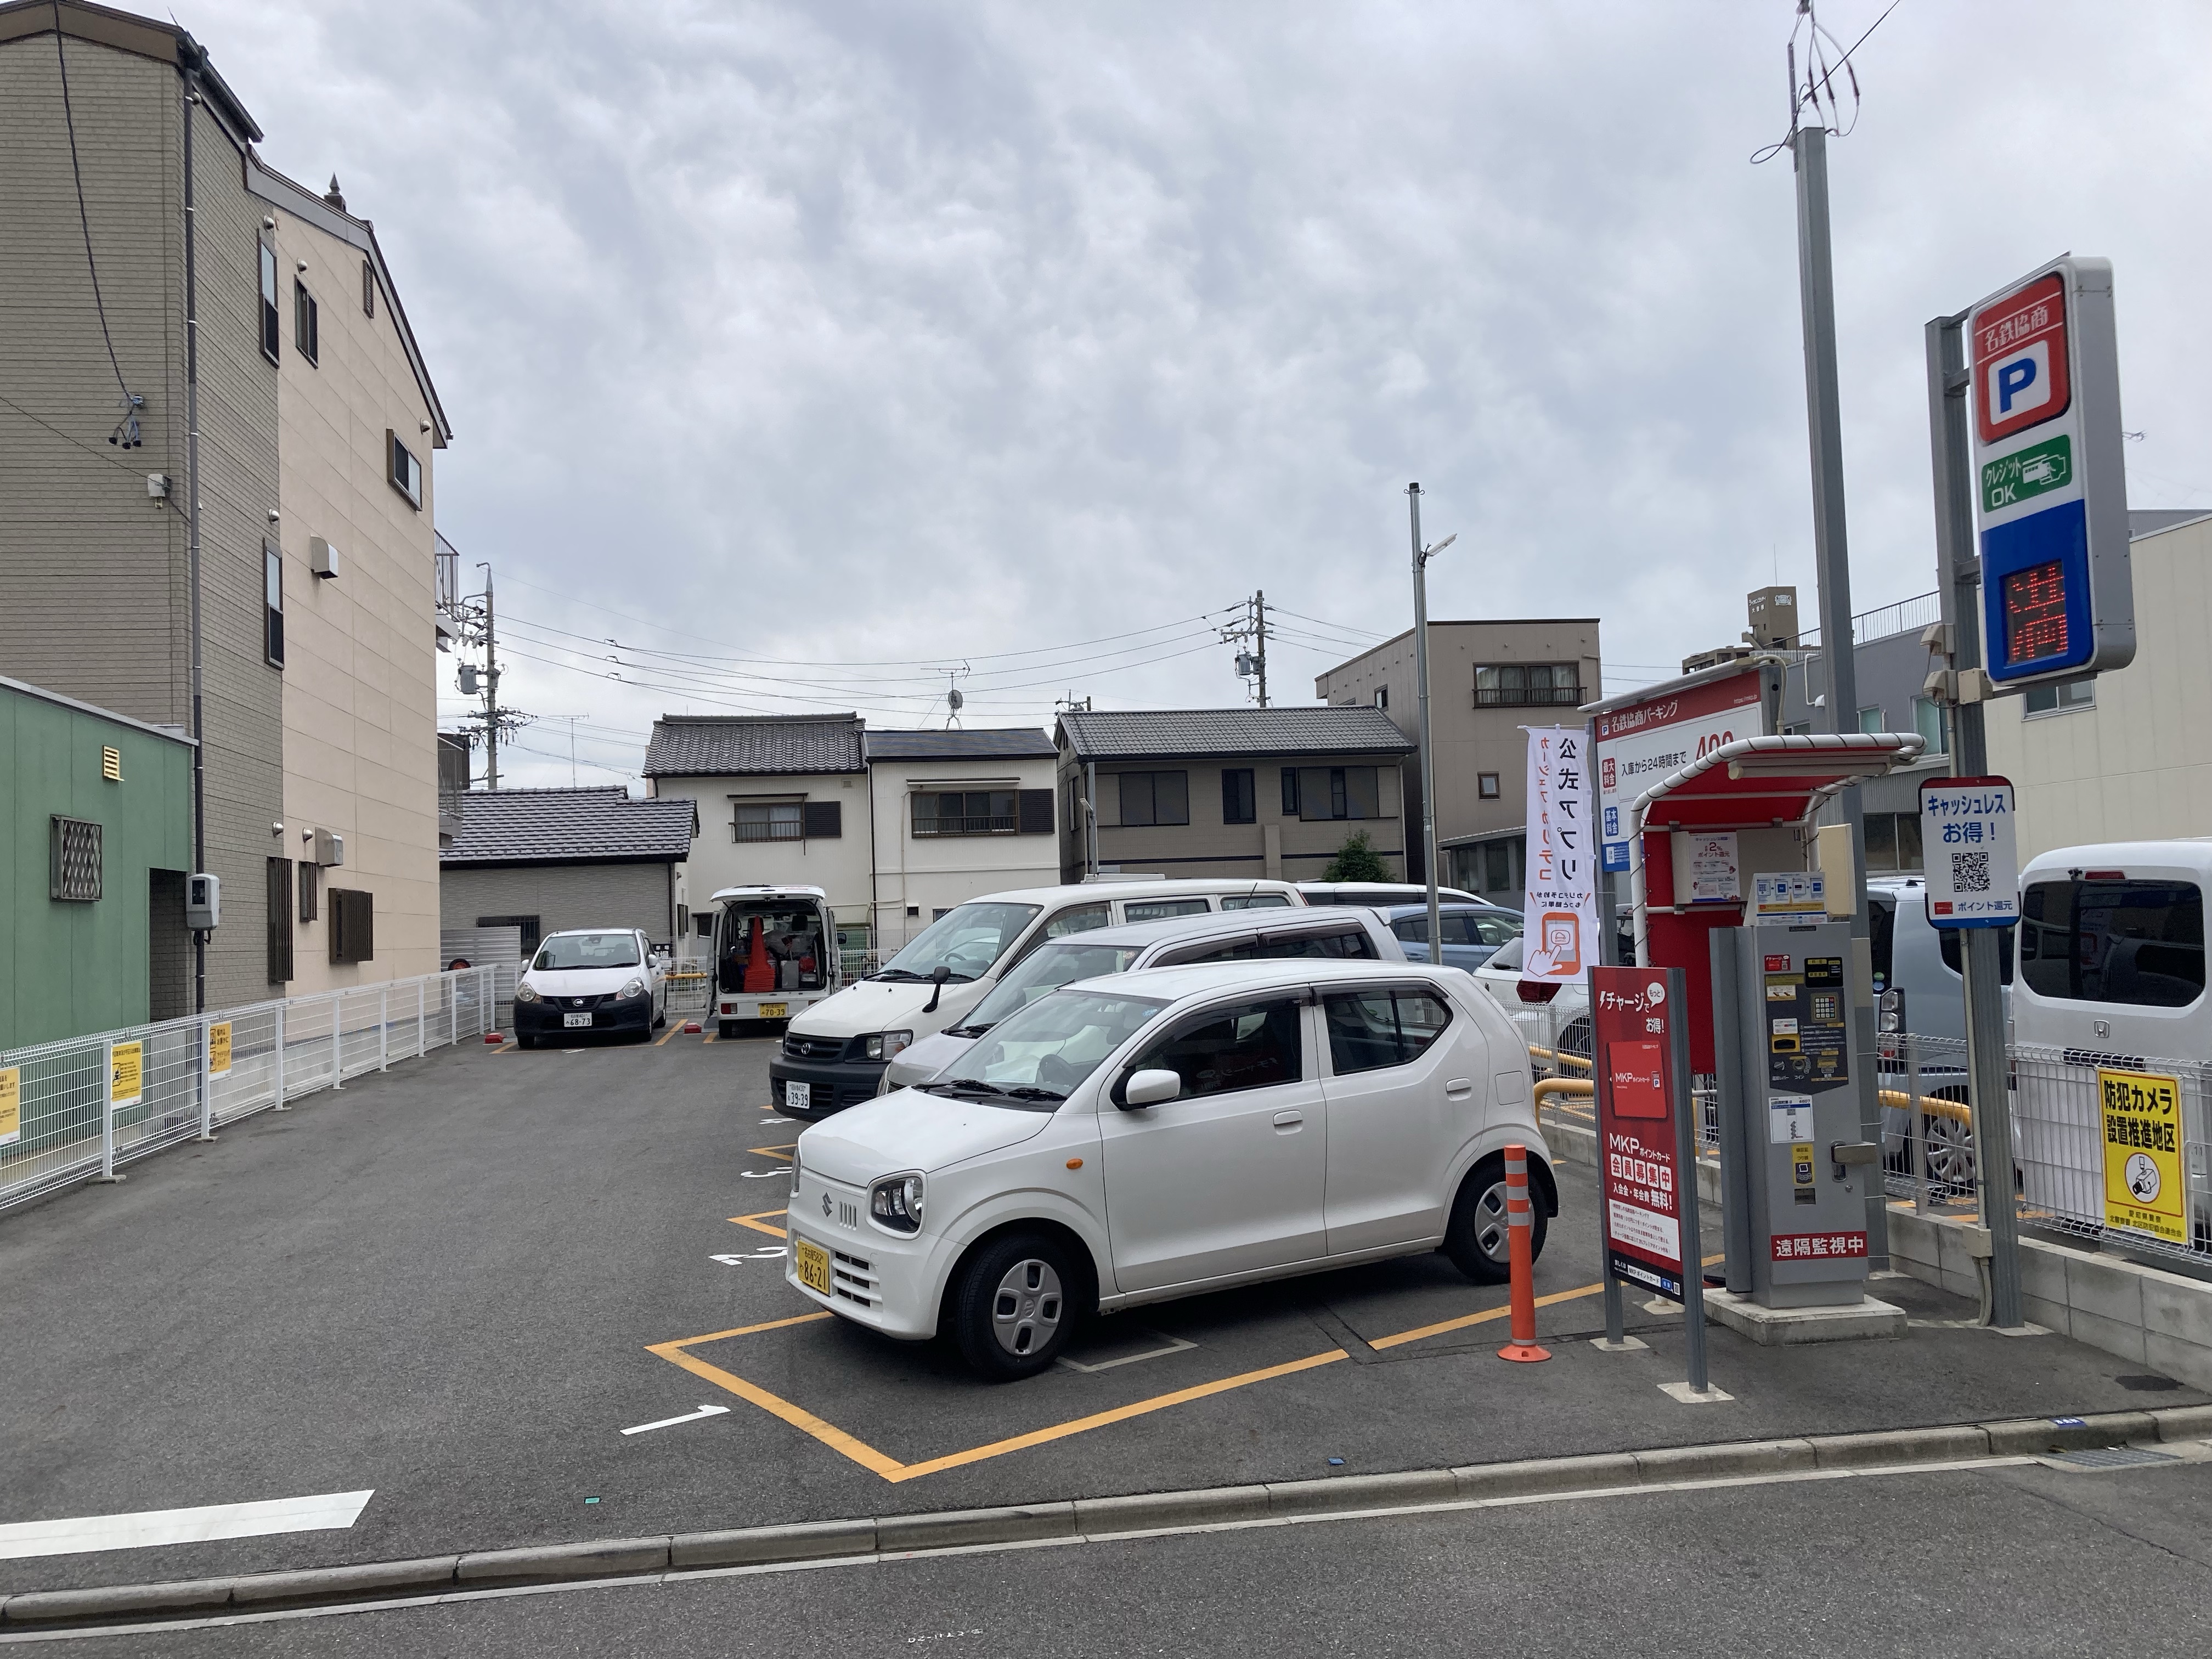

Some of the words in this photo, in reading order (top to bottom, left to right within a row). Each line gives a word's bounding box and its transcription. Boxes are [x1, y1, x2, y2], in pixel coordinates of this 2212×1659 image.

[1985, 305, 2049, 352] 名鉄協商
[1998, 358, 2036, 414] P
[1986, 456, 2022, 487] クレジット
[1991, 483, 2017, 507] OK
[1612, 699, 1678, 732] 名鉄協商パーキング
[1603, 760, 1615, 773] 最大
[1621, 751, 1686, 777] 入庫から24時間まで
[1604, 774, 1615, 786] 料金
[1605, 809, 1617, 822] 基本
[1928, 794, 2006, 816] キャッシュレス
[1606, 822, 1618, 834] 料金
[570, 1018, 591, 1026] 68-73
[1646, 1017, 1664, 1034] お得!
[791, 1092, 808, 1107] 39-39
[2104, 1080, 2172, 1115] 防犯カメラ
[2106, 1114, 2176, 1153] 設置推進地区
[1612, 1156, 1671, 1188] 会員募集中
[1776, 1236, 1864, 1257] 遠隔監視中
[804, 1260, 826, 1290] 86-21
